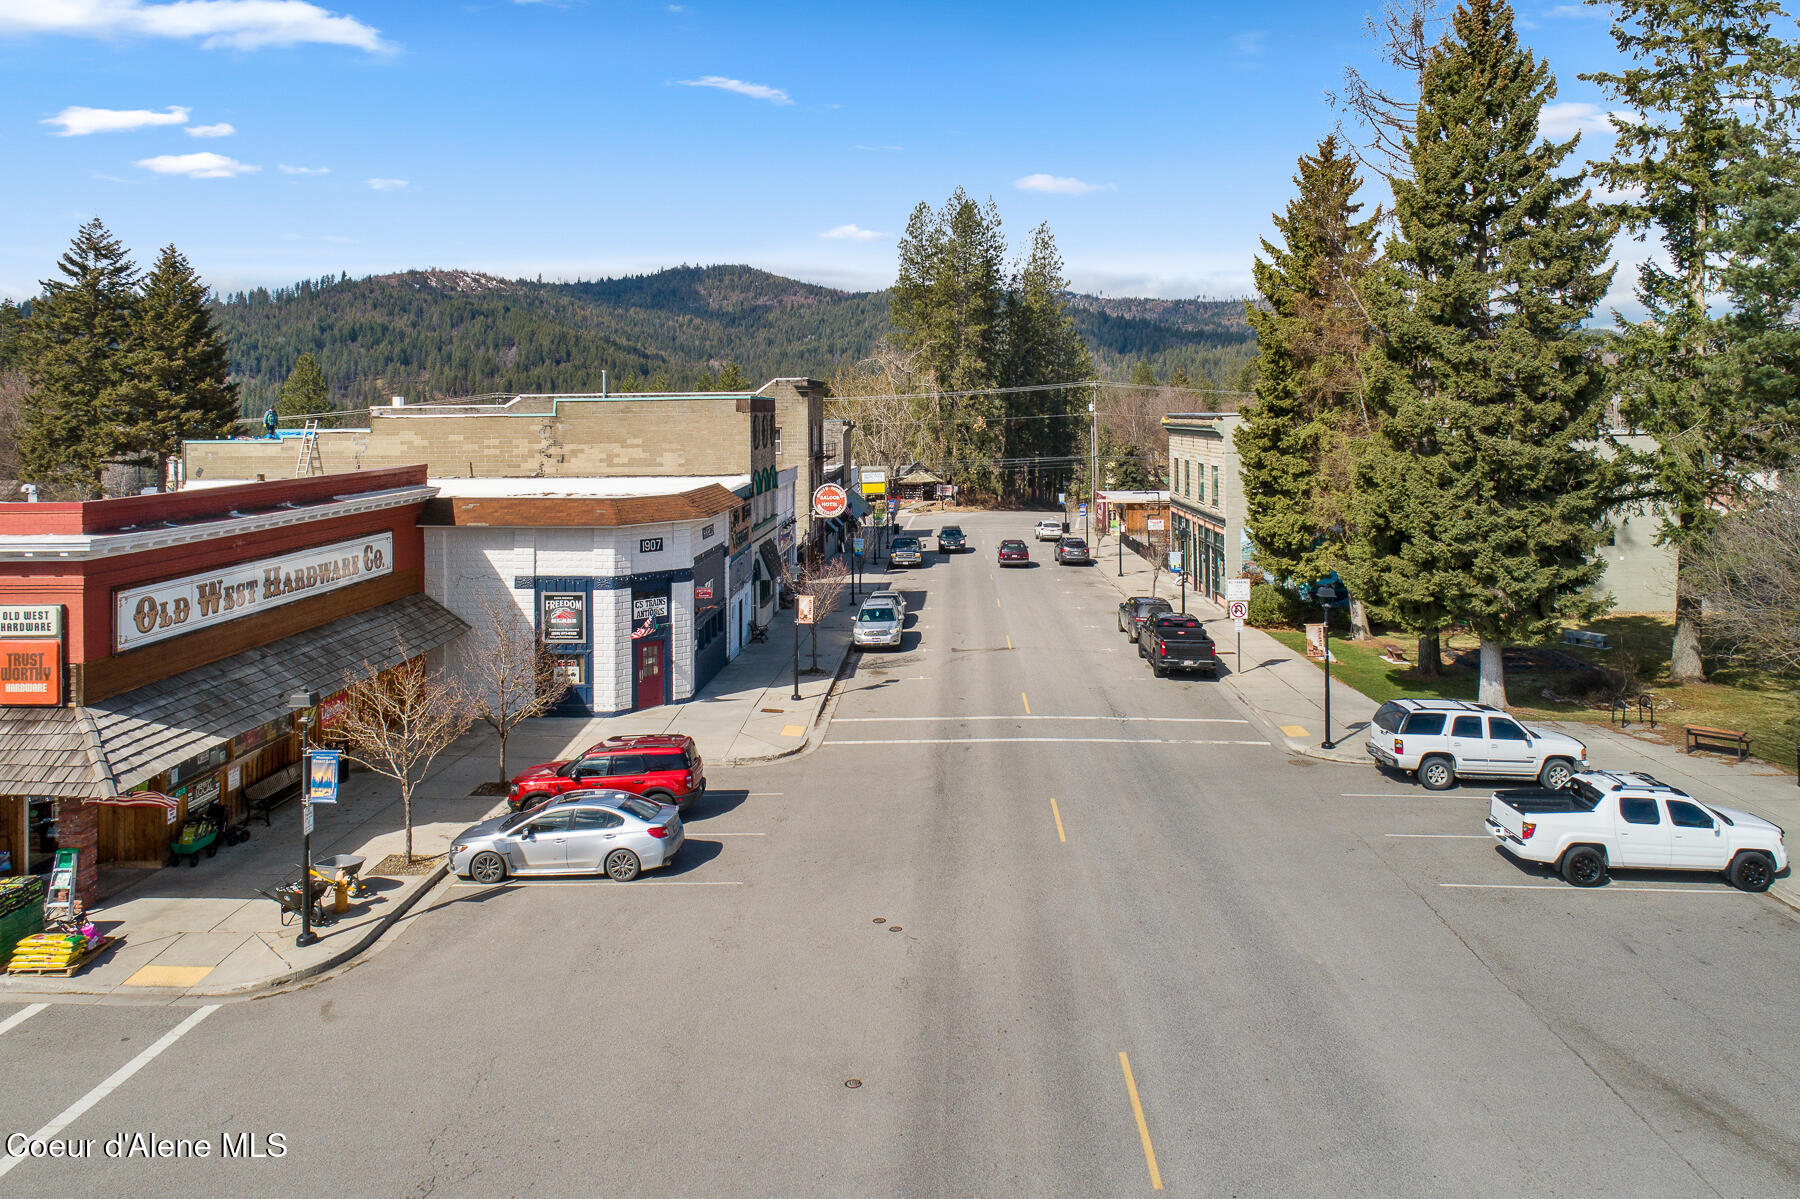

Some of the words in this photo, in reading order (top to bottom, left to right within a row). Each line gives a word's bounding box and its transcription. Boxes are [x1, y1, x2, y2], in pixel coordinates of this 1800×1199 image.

[642, 540, 661, 552] 1907
[134, 595, 191, 634] OLD
[196, 579, 259, 617] WEST
[262, 554, 360, 600] HARDWARE
[545, 600, 582, 611] FREEDOM
[645, 598, 666, 607] TRAINS
[2, 611, 20, 620] OLD
[23, 611, 49, 620] WEST
[0, 622, 51, 632] HARDWARE
[6, 653, 45, 667] TRUST
[1, 667, 51, 681] WORTHY
[5, 683, 48, 693] HARDWARE
